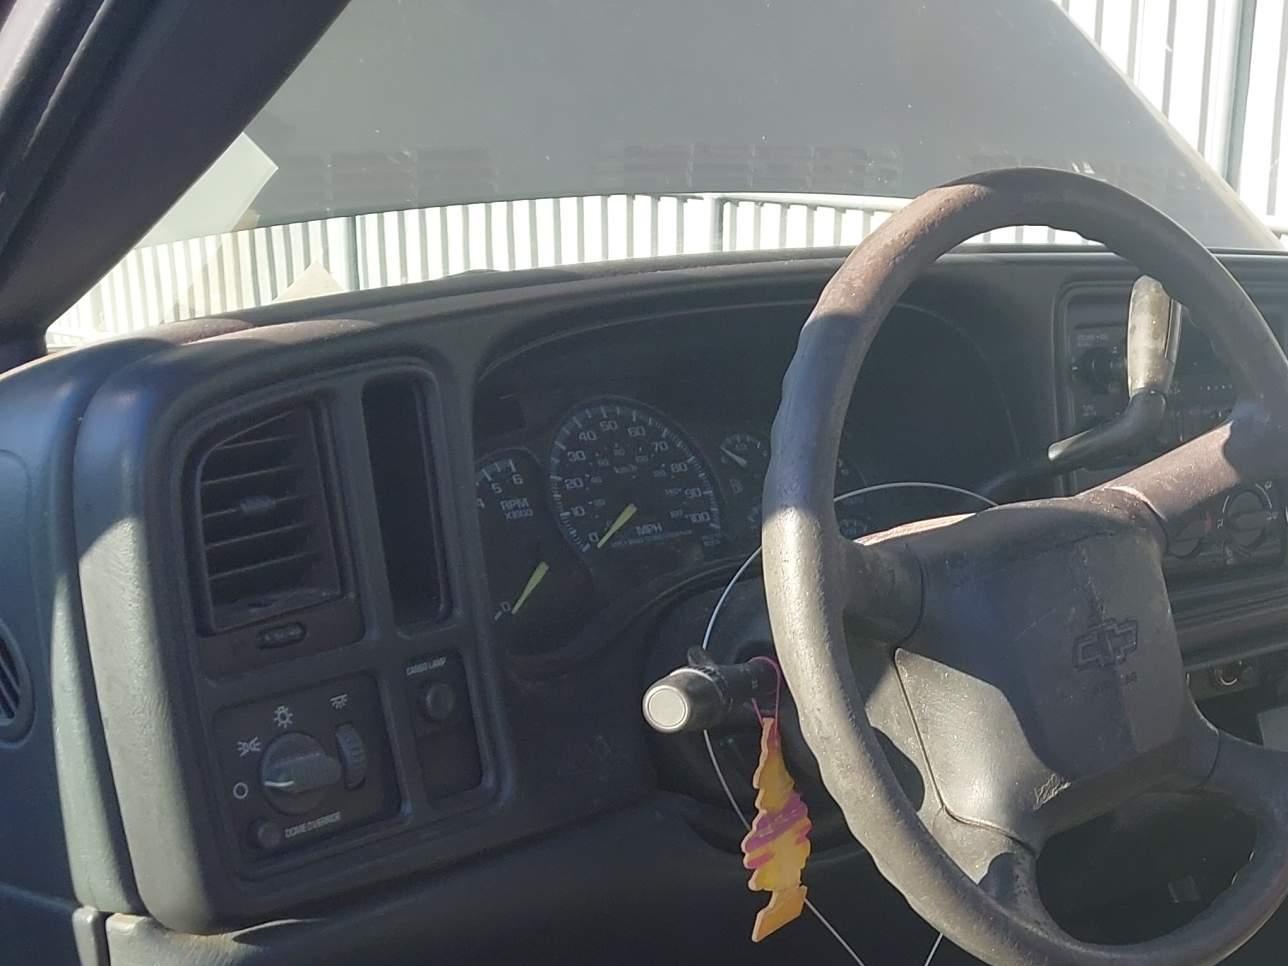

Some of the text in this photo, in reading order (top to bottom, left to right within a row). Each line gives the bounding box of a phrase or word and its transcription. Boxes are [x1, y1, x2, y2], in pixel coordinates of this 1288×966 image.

[599, 420, 618, 432] 50
[627, 425, 646, 438] 60
[578, 430, 597, 441] 40
[651, 440, 669, 452] 70
[567, 450, 586, 462] 30
[511, 473, 524, 485] 6
[564, 477, 584, 490] 20
[491, 482, 503, 494] 5
[500, 497, 530, 512] RPM
[571, 505, 586, 517] 10
[635, 522, 663, 536] MPH
